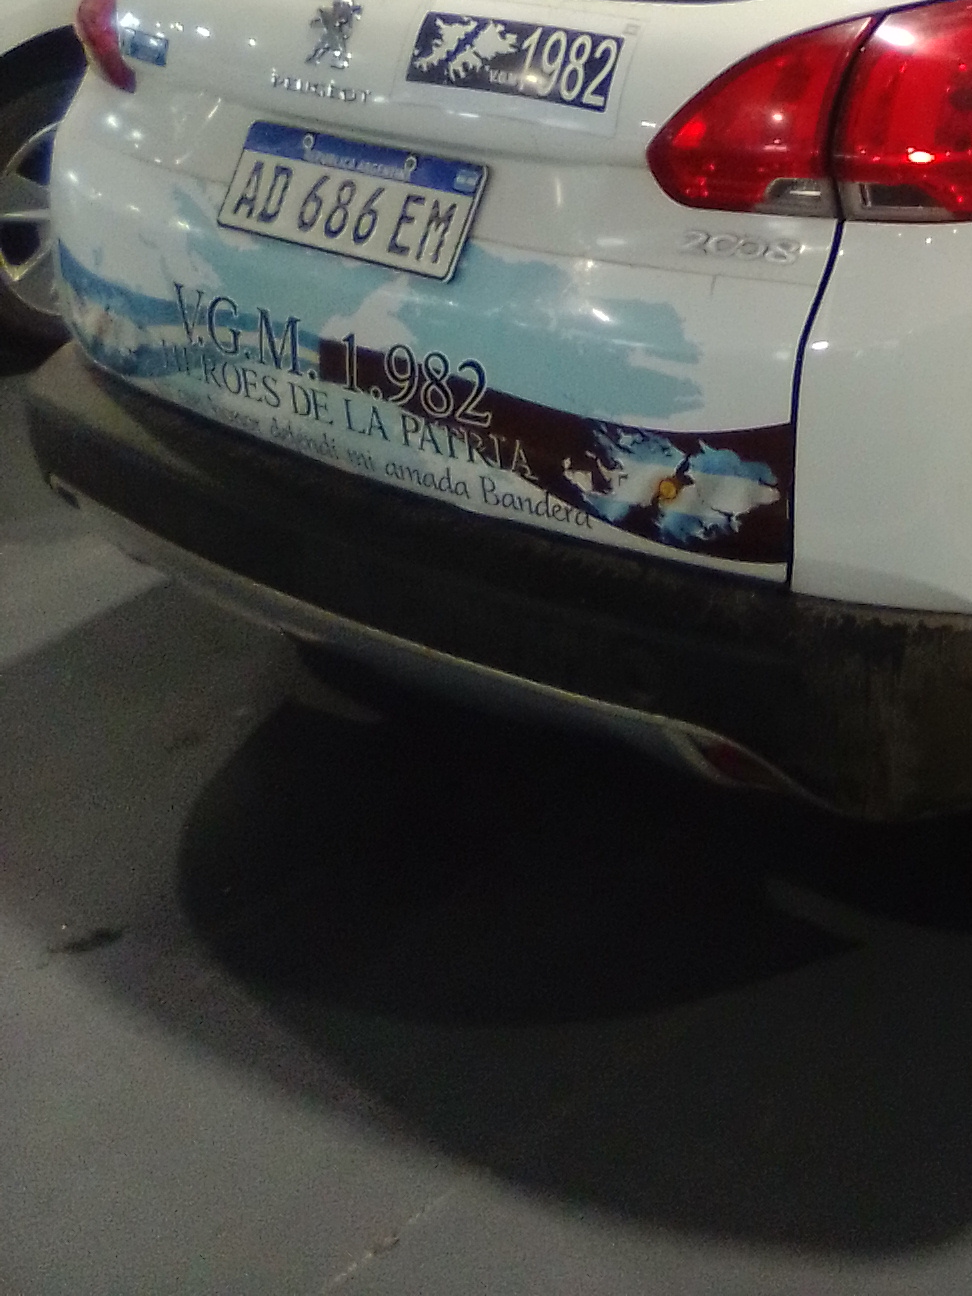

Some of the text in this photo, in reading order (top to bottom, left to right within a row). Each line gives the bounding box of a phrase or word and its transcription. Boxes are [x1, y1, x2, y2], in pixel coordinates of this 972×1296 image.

[520, 26, 618, 107] 1982
[233, 160, 293, 224] AD
[298, 174, 386, 246] 686
[387, 194, 458, 265] EM
[173, 281, 319, 382] V.G.M.
[339, 331, 493, 430] 1.982
[287, 380, 334, 426] DE
[343, 397, 391, 443] LA
[401, 410, 539, 482] PATRIA
[385, 460, 471, 501] amada
[478, 474, 593, 530] Bandera
